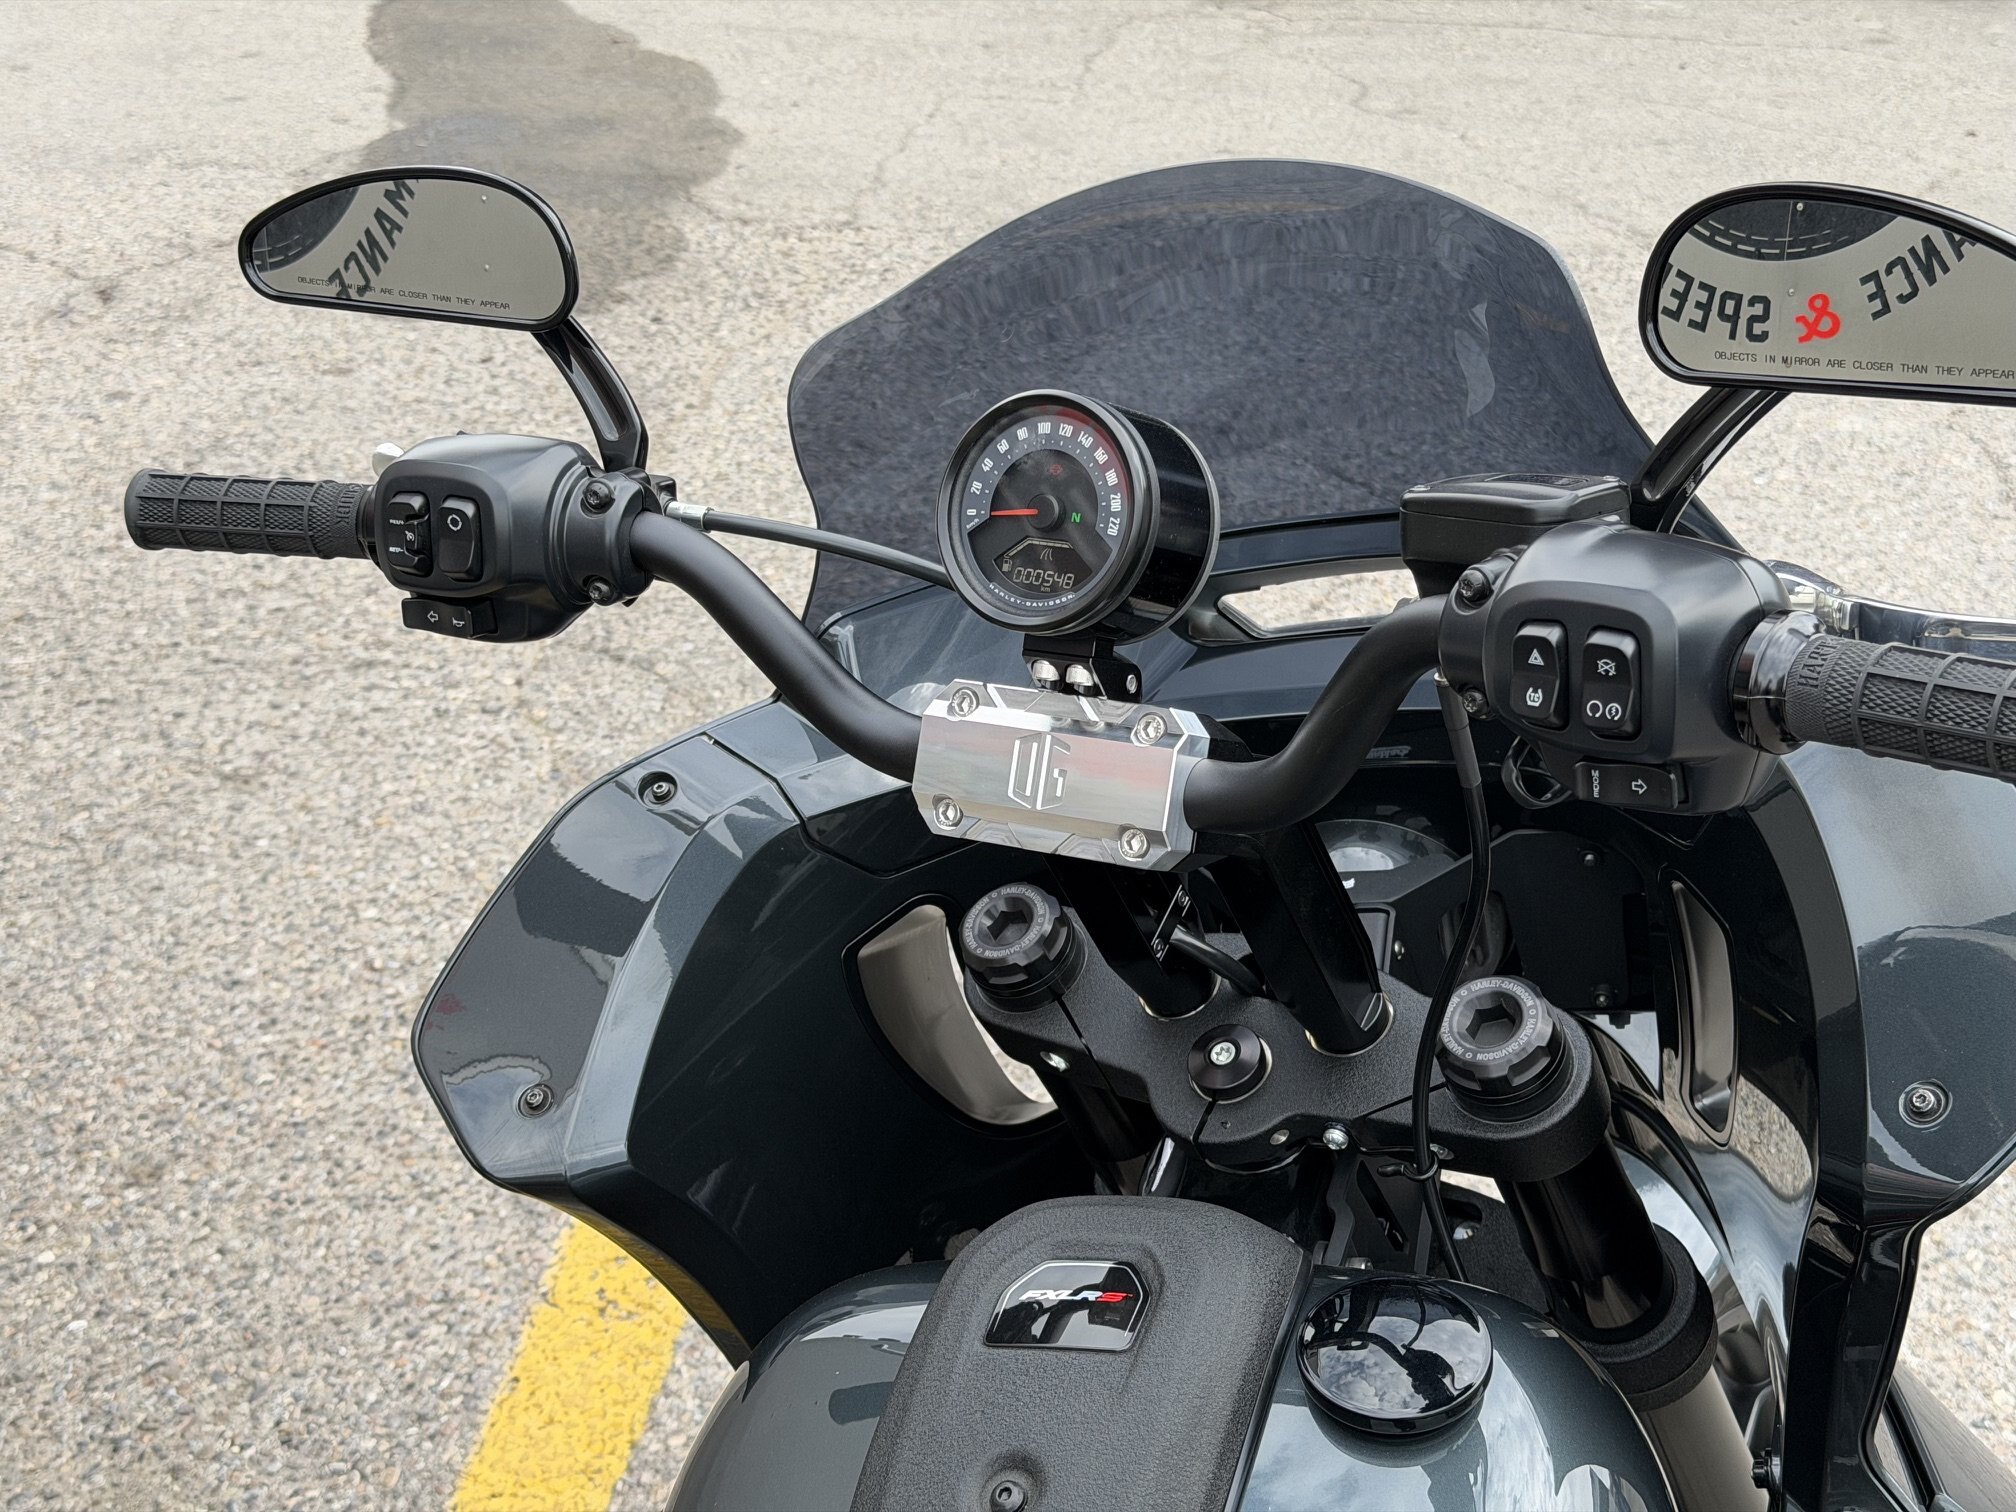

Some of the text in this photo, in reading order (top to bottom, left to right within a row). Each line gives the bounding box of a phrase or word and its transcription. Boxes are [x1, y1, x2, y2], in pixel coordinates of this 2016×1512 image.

[297, 276, 330, 287] OBJECTS
[380, 287, 395, 296] ARE
[398, 289, 428, 300] CLOSER
[432, 293, 452, 303] THAN
[456, 296, 476, 306] THEY
[479, 300, 510, 310] APPEAR
[1714, 350, 2015, 380] OBJECTS IN MIRROR ARE CLOSER THAN THEY APPEAR
[1016, 426, 1028, 441] 80
[1037, 422, 1051, 435] 100
[1059, 423, 1073, 438] 120
[996, 438, 1009, 454] 60
[1077, 430, 1094, 449] 140
[981, 457, 994, 473] 40
[1093, 446, 1109, 465] 160
[1104, 468, 1119, 487] 180
[970, 480, 983, 495] 20
[1109, 492, 1122, 512] 200
[966, 508, 977, 516] 0
[1071, 511, 1081, 523] N
[1106, 516, 1121, 537] 220
[1013, 566, 1075, 589] 000548
[1040, 584, 1051, 593] km
[1591, 769, 1600, 799] MODE
[1470, 979, 1535, 1008] HARLEY-DAVIDSON
[1476, 1018, 1536, 1060] HARLEY-DAVIDSON
